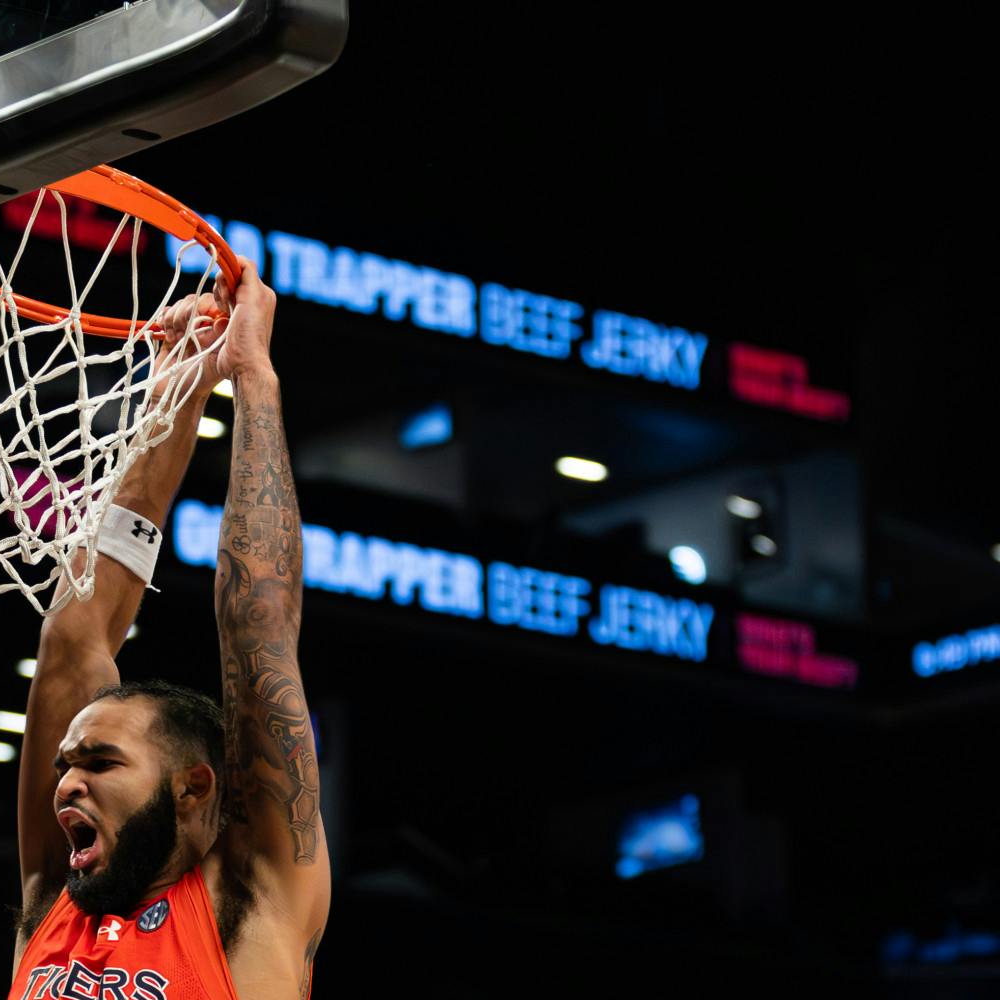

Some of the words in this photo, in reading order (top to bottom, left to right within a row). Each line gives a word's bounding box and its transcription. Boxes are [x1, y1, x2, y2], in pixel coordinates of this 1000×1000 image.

[266, 231, 477, 338] TRAPPER
[479, 283, 584, 360] BEEF
[581, 310, 708, 389] JERKY
[231, 513, 251, 555] Built
[302, 524, 485, 619] RAPPER
[487, 561, 592, 635] BEEF
[589, 584, 713, 661] JERKY
